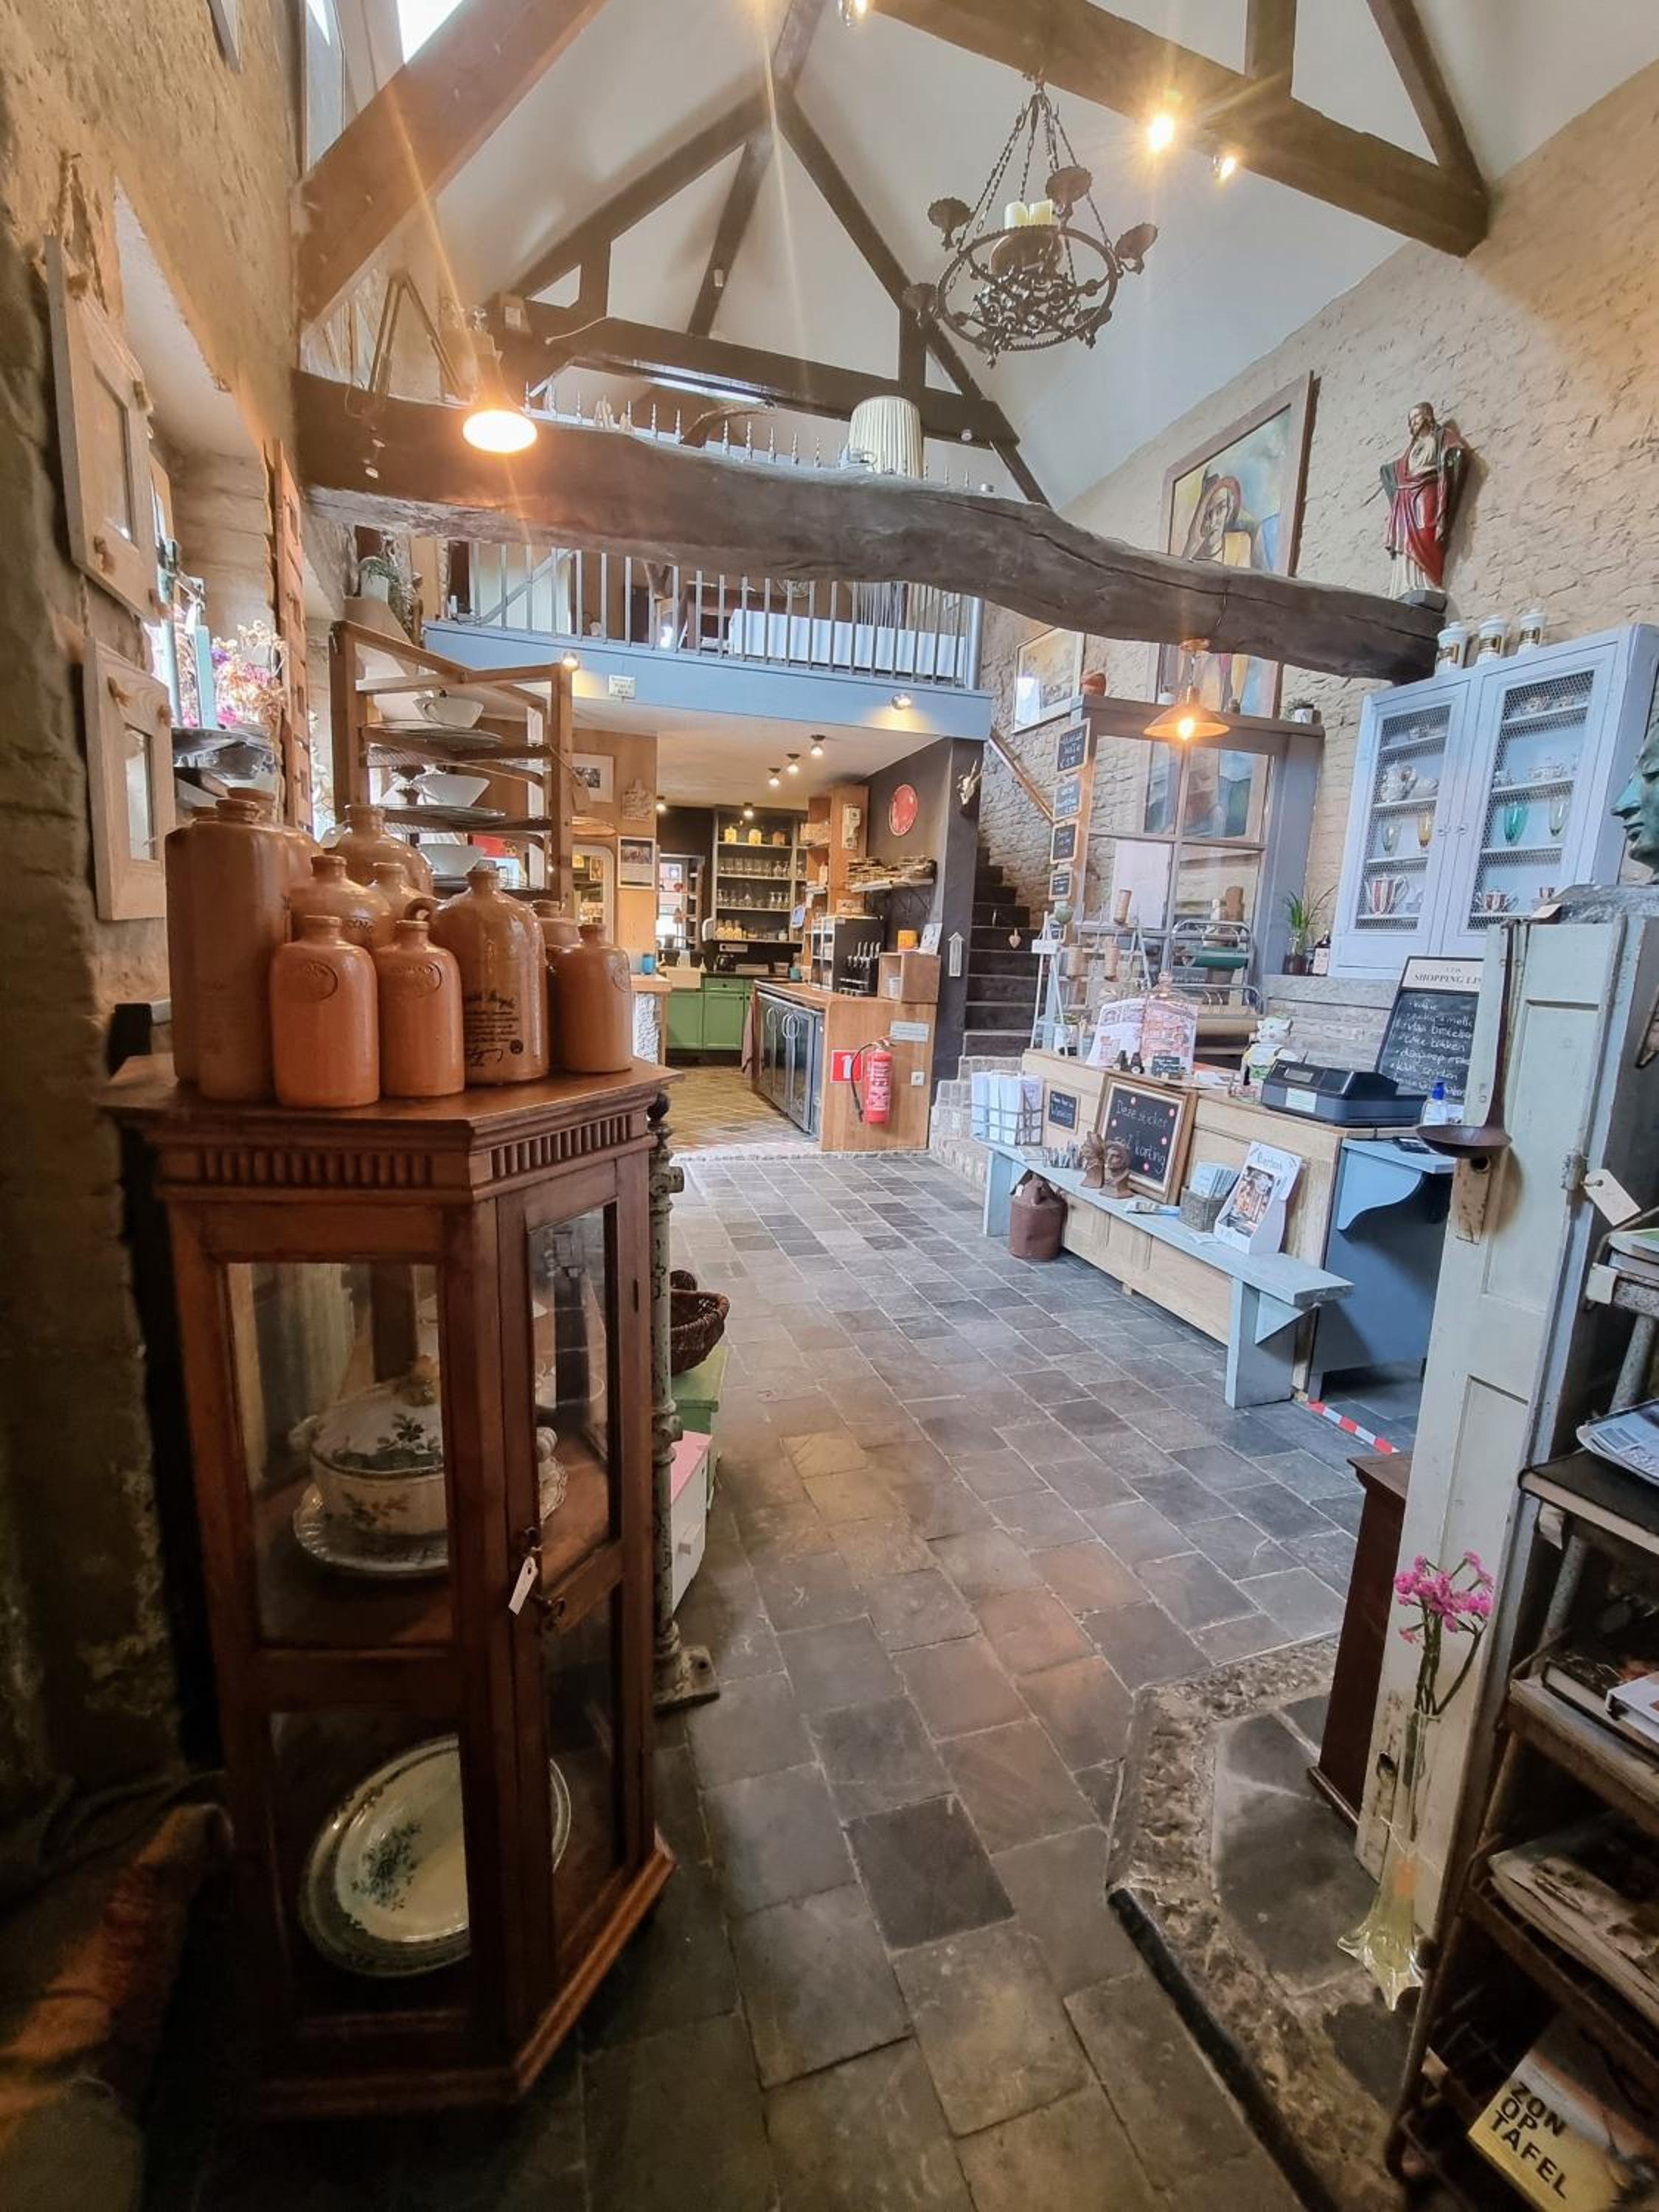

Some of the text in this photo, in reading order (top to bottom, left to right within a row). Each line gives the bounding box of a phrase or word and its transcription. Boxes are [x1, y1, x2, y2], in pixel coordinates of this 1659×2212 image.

[1414, 973, 1464, 984] SHOPPING
[1134, 1144, 1166, 1175] korting
[1500, 2096, 1538, 2130] OP
[1510, 2081, 1567, 2138] ZON
[1491, 2110, 1567, 2199] TAFEL
